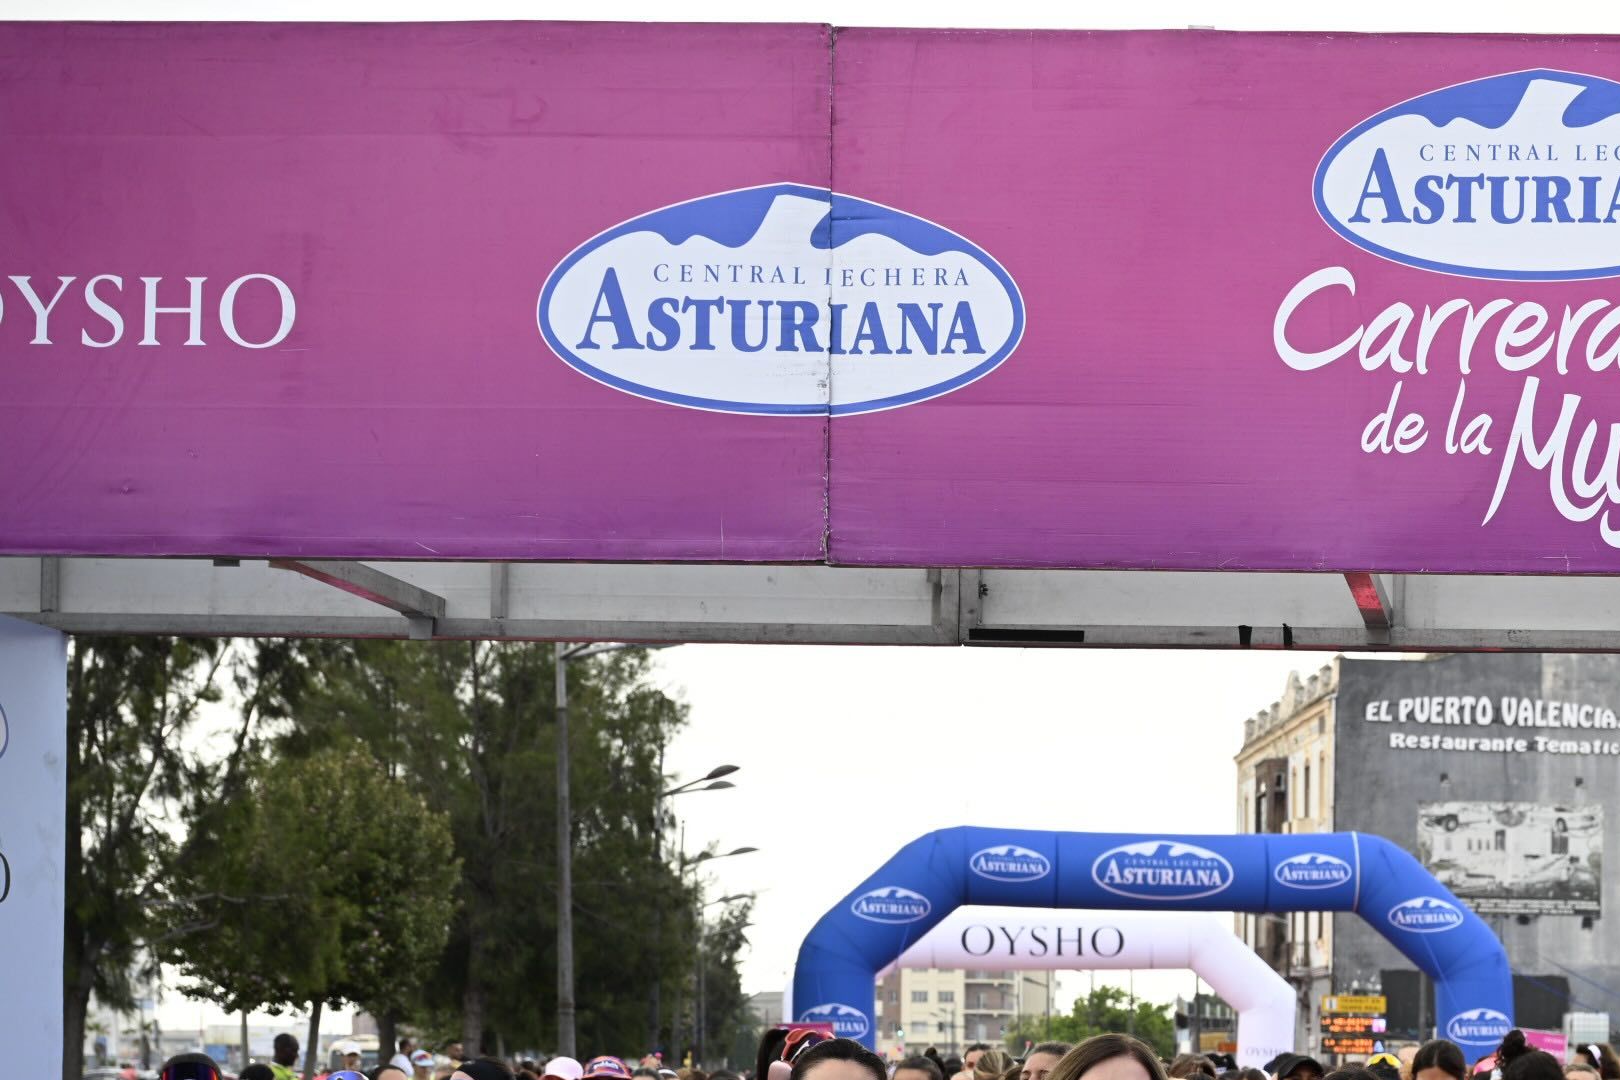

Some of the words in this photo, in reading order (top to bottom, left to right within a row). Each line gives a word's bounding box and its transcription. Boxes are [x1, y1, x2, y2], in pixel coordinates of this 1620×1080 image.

[1419, 144, 1559, 162] CENTRAL
[653, 263, 806, 285] CENTRAL
[0, 272, 297, 349] YSHO
[576, 267, 986, 355] ASTURIANA
[1361, 381, 1428, 455] de
[1445, 378, 1492, 455] la
[1364, 700, 1393, 723] EL
[1398, 696, 1494, 726] PUERTO
[1389, 732, 1527, 752] Restaurante
[973, 856, 1045, 874] ASTURIANA
[1103, 858, 1223, 887] ASTURIANA
[1281, 864, 1346, 881] ASTURIANA
[855, 897, 925, 916] ASTURIANA
[1395, 907, 1460, 925] ASTURIANA
[960, 924, 1125, 957] OYSHO
